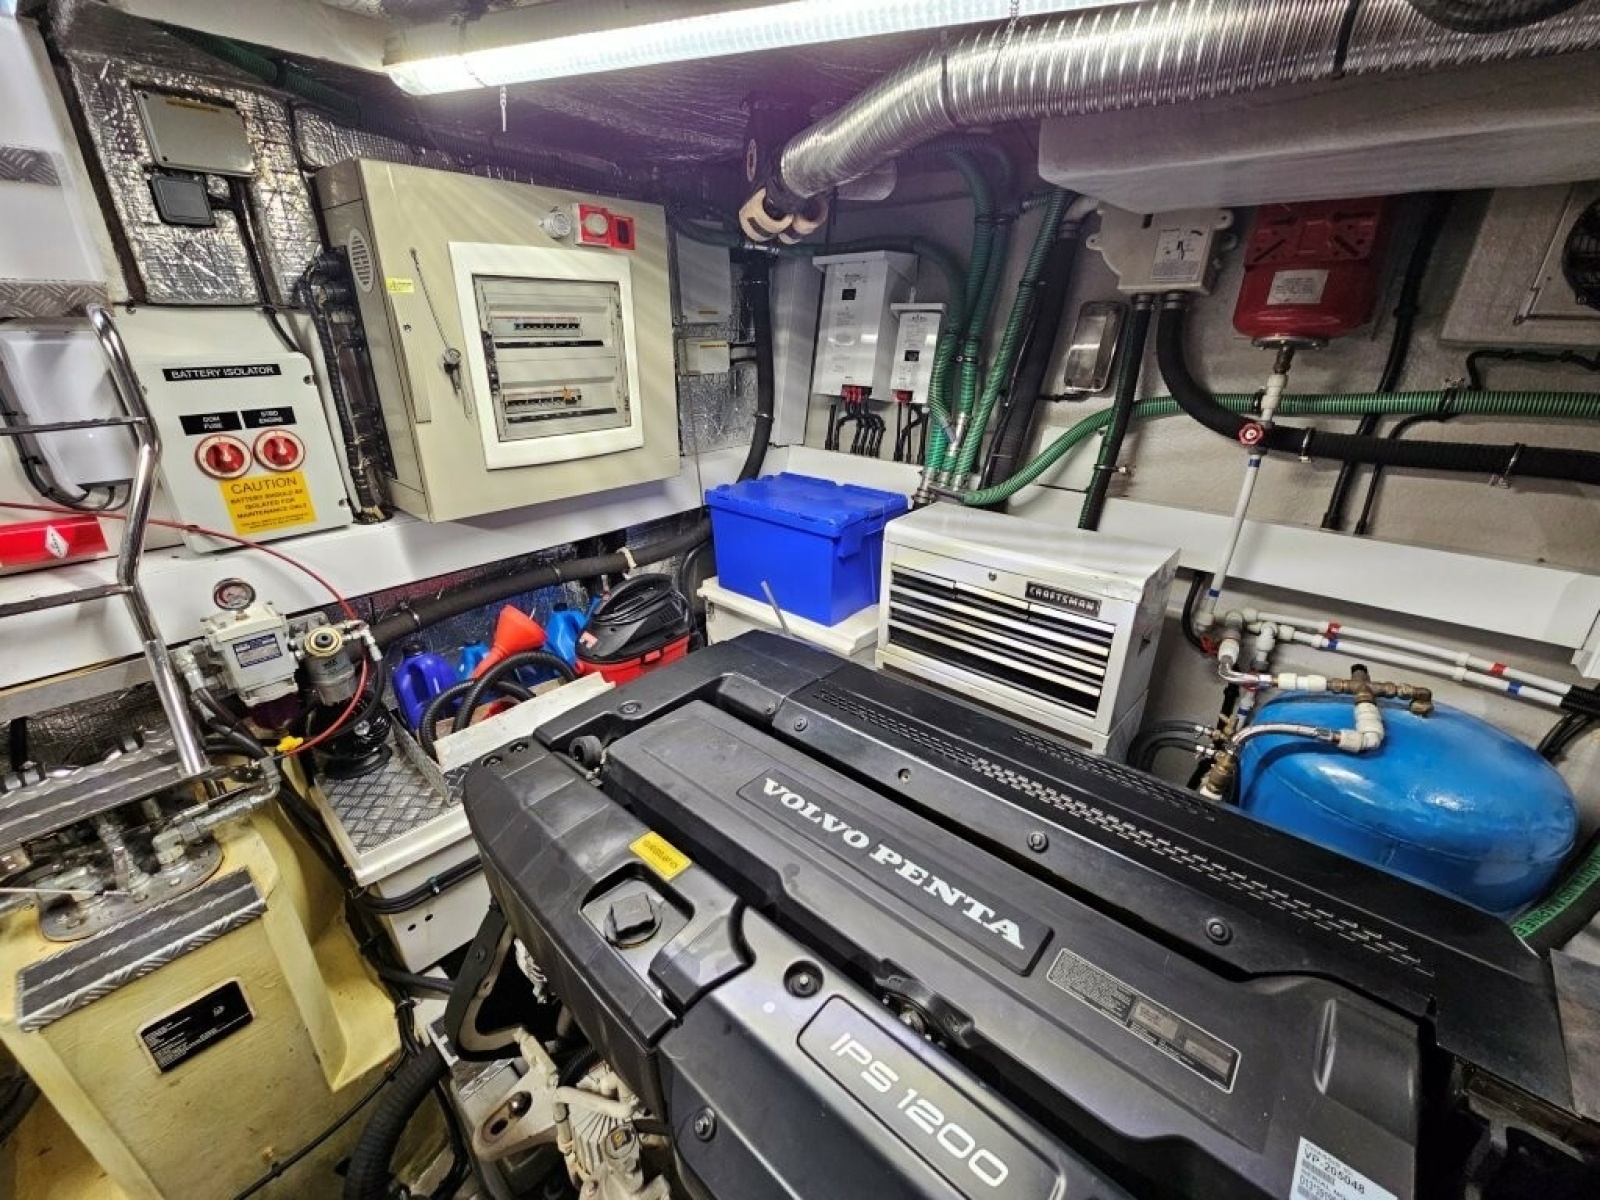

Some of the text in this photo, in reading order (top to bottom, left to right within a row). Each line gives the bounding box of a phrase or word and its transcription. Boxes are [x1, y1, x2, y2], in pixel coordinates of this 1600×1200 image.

[171, 365, 275, 379] BATTERY ISOLATOR
[231, 477, 297, 494] CAUTION
[1029, 585, 1095, 611] CRAFTSMAN
[763, 778, 1025, 950] VOLVO PENTA
[830, 1033, 1009, 1187] IPS 1200
